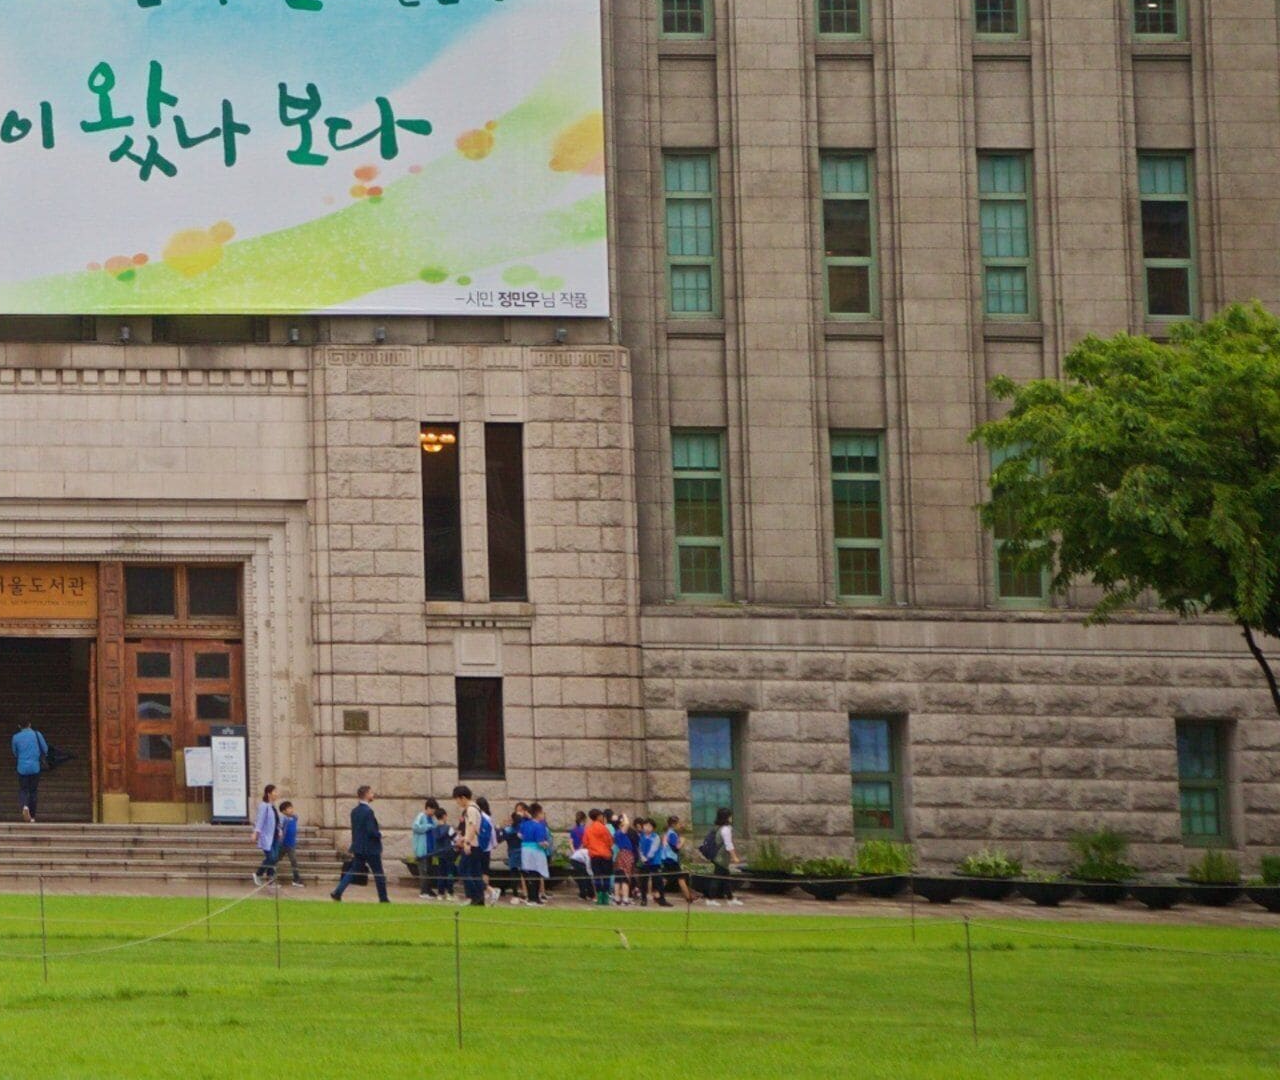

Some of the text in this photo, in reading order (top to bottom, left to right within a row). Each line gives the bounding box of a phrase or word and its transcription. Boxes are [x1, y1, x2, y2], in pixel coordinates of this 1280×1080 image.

[80, 60, 251, 181] 왔나
[277, 82, 433, 166] 보다
[560, 291, 588, 309] 작품
